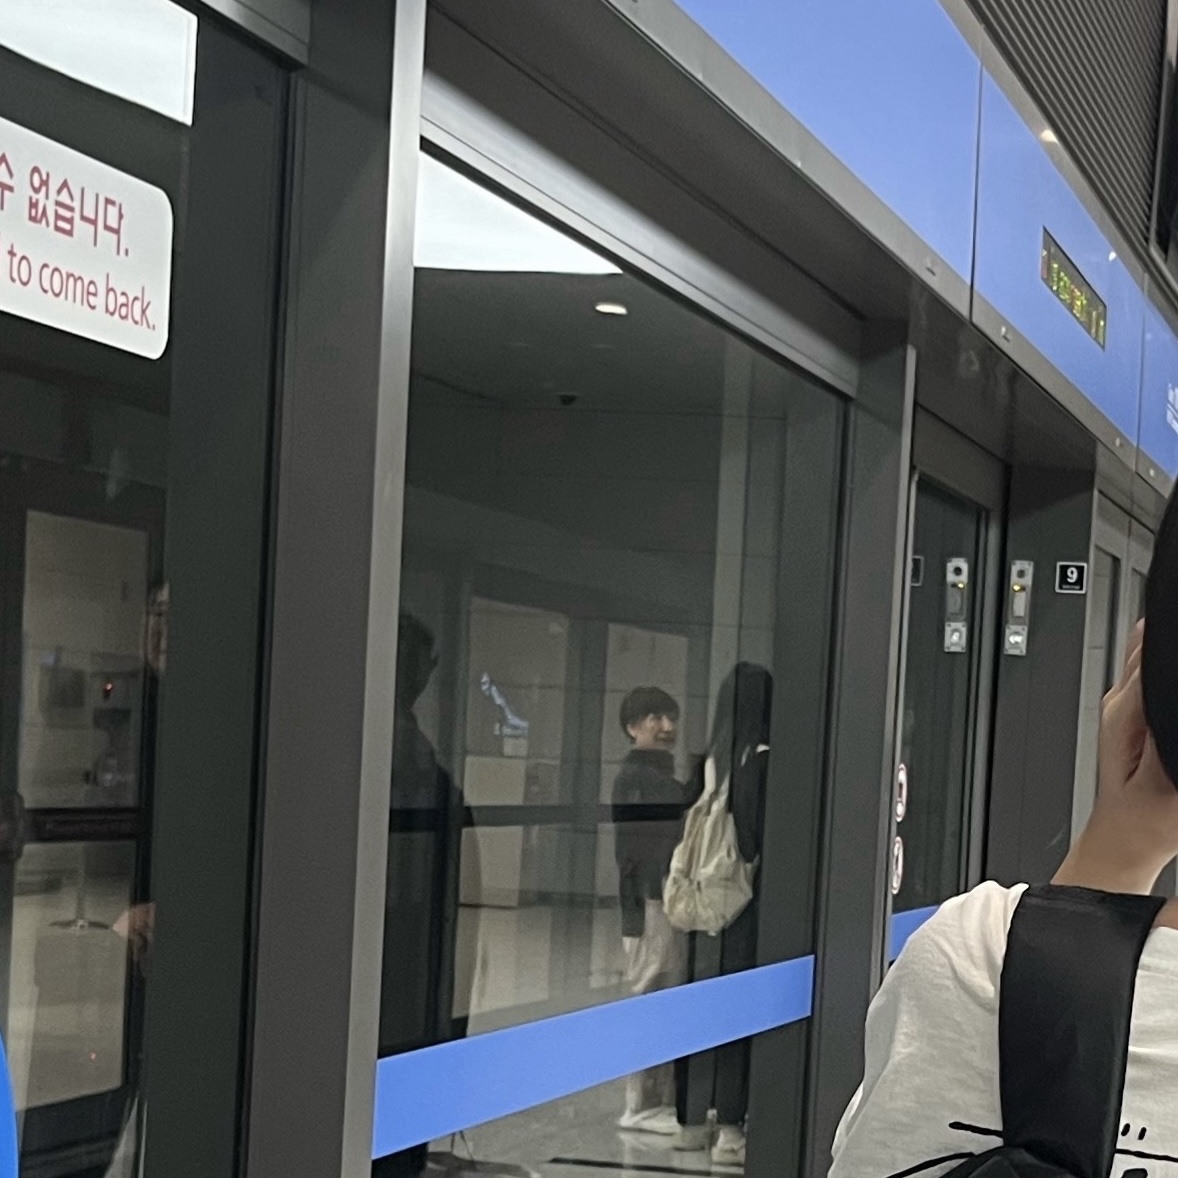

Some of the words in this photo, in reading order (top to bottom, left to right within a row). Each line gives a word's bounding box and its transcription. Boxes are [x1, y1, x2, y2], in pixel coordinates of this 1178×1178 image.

[28, 165, 130, 258] 없습니다.
[7, 243, 32, 287] to
[39, 262, 98, 311] come
[105, 272, 156, 331] back.
[1066, 567, 1079, 583] 9
